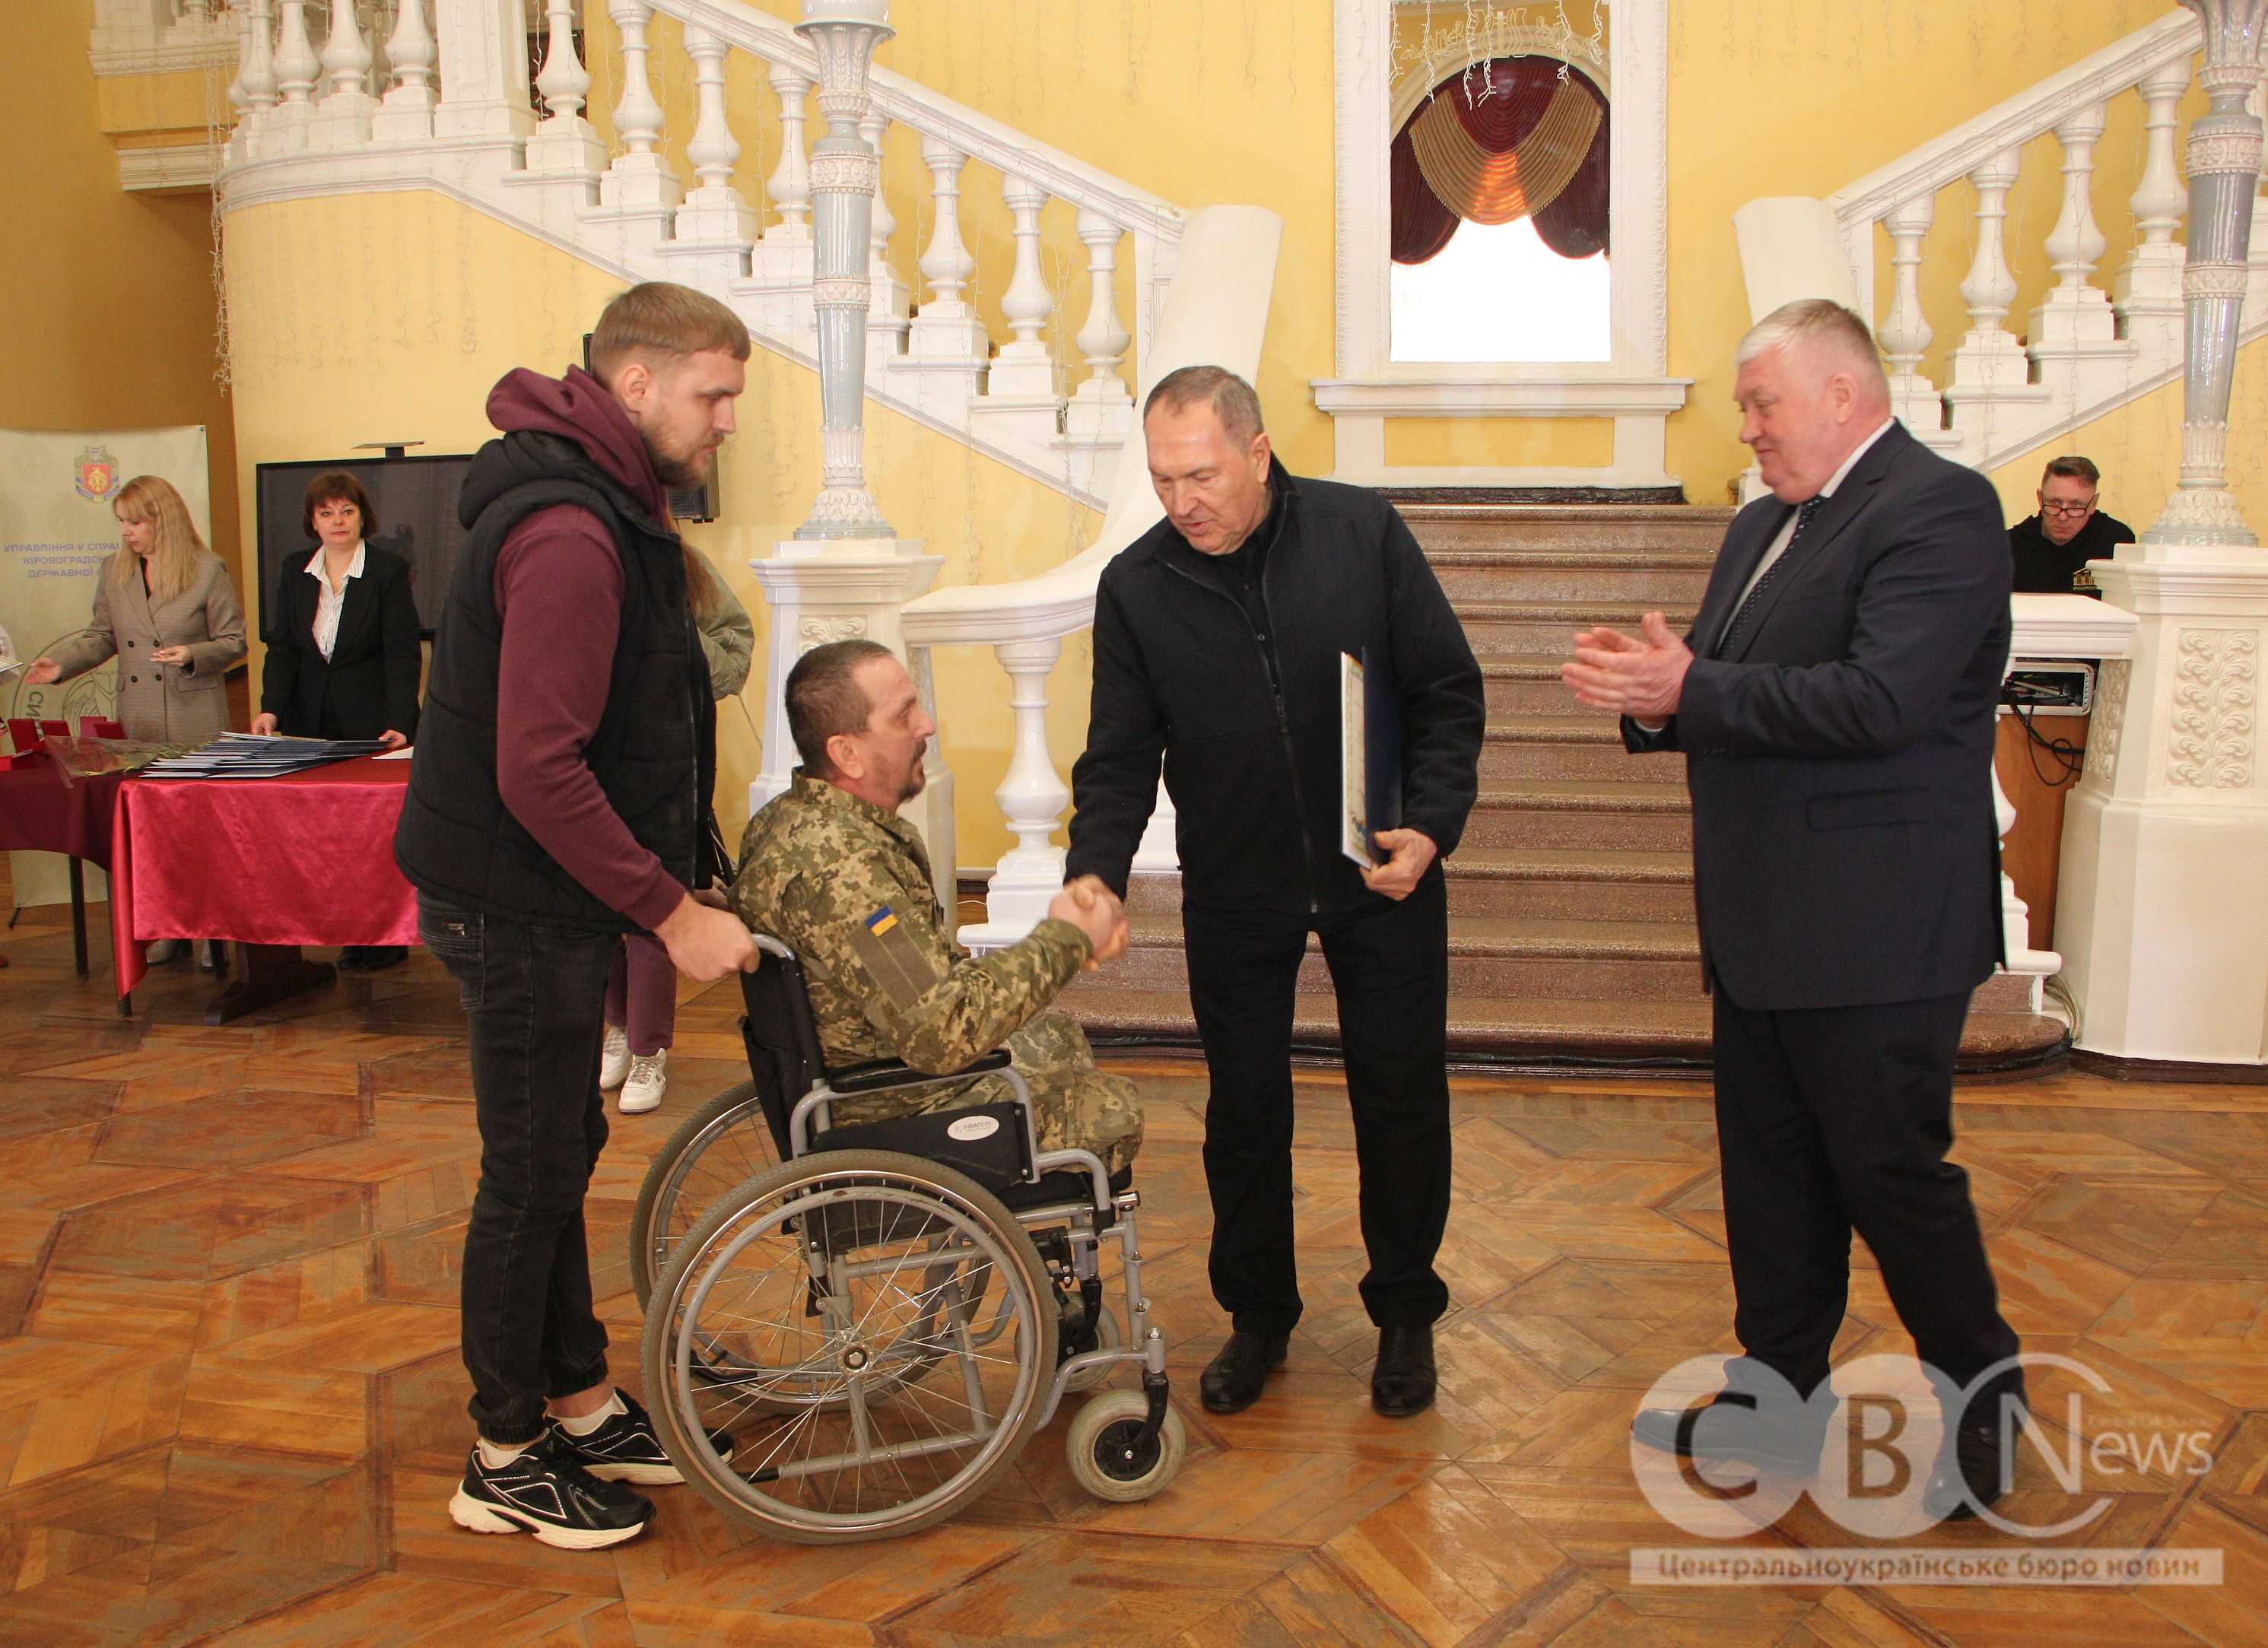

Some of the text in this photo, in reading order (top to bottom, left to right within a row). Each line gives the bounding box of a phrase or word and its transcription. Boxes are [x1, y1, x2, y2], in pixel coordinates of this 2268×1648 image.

[4, 543, 74, 553] УПРАВЛІННЯ
[87, 542, 119, 551] СПРА
[26, 691, 43, 720] СИ
